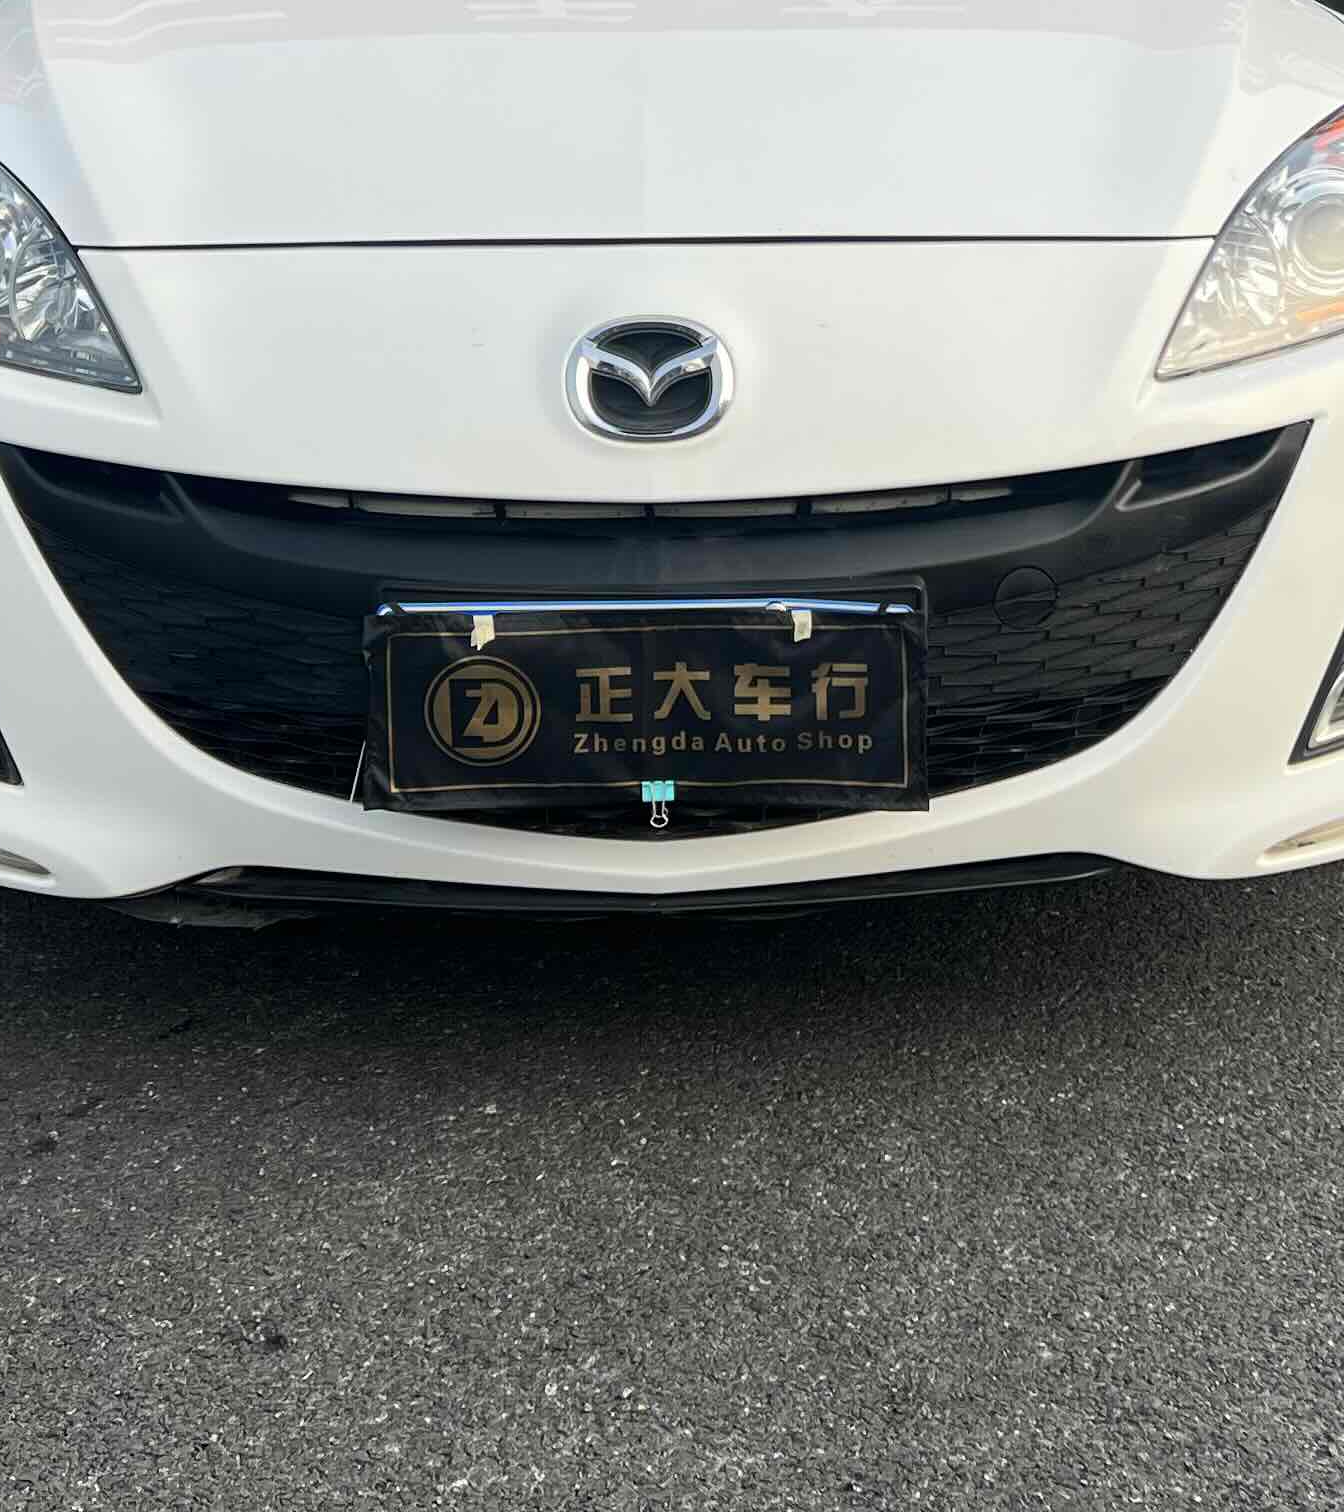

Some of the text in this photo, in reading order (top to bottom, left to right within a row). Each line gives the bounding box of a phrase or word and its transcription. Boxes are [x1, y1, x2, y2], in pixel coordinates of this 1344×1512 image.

[575, 661, 869, 723] 正大车行
[573, 730, 874, 755] Zhengda Auto Shop
